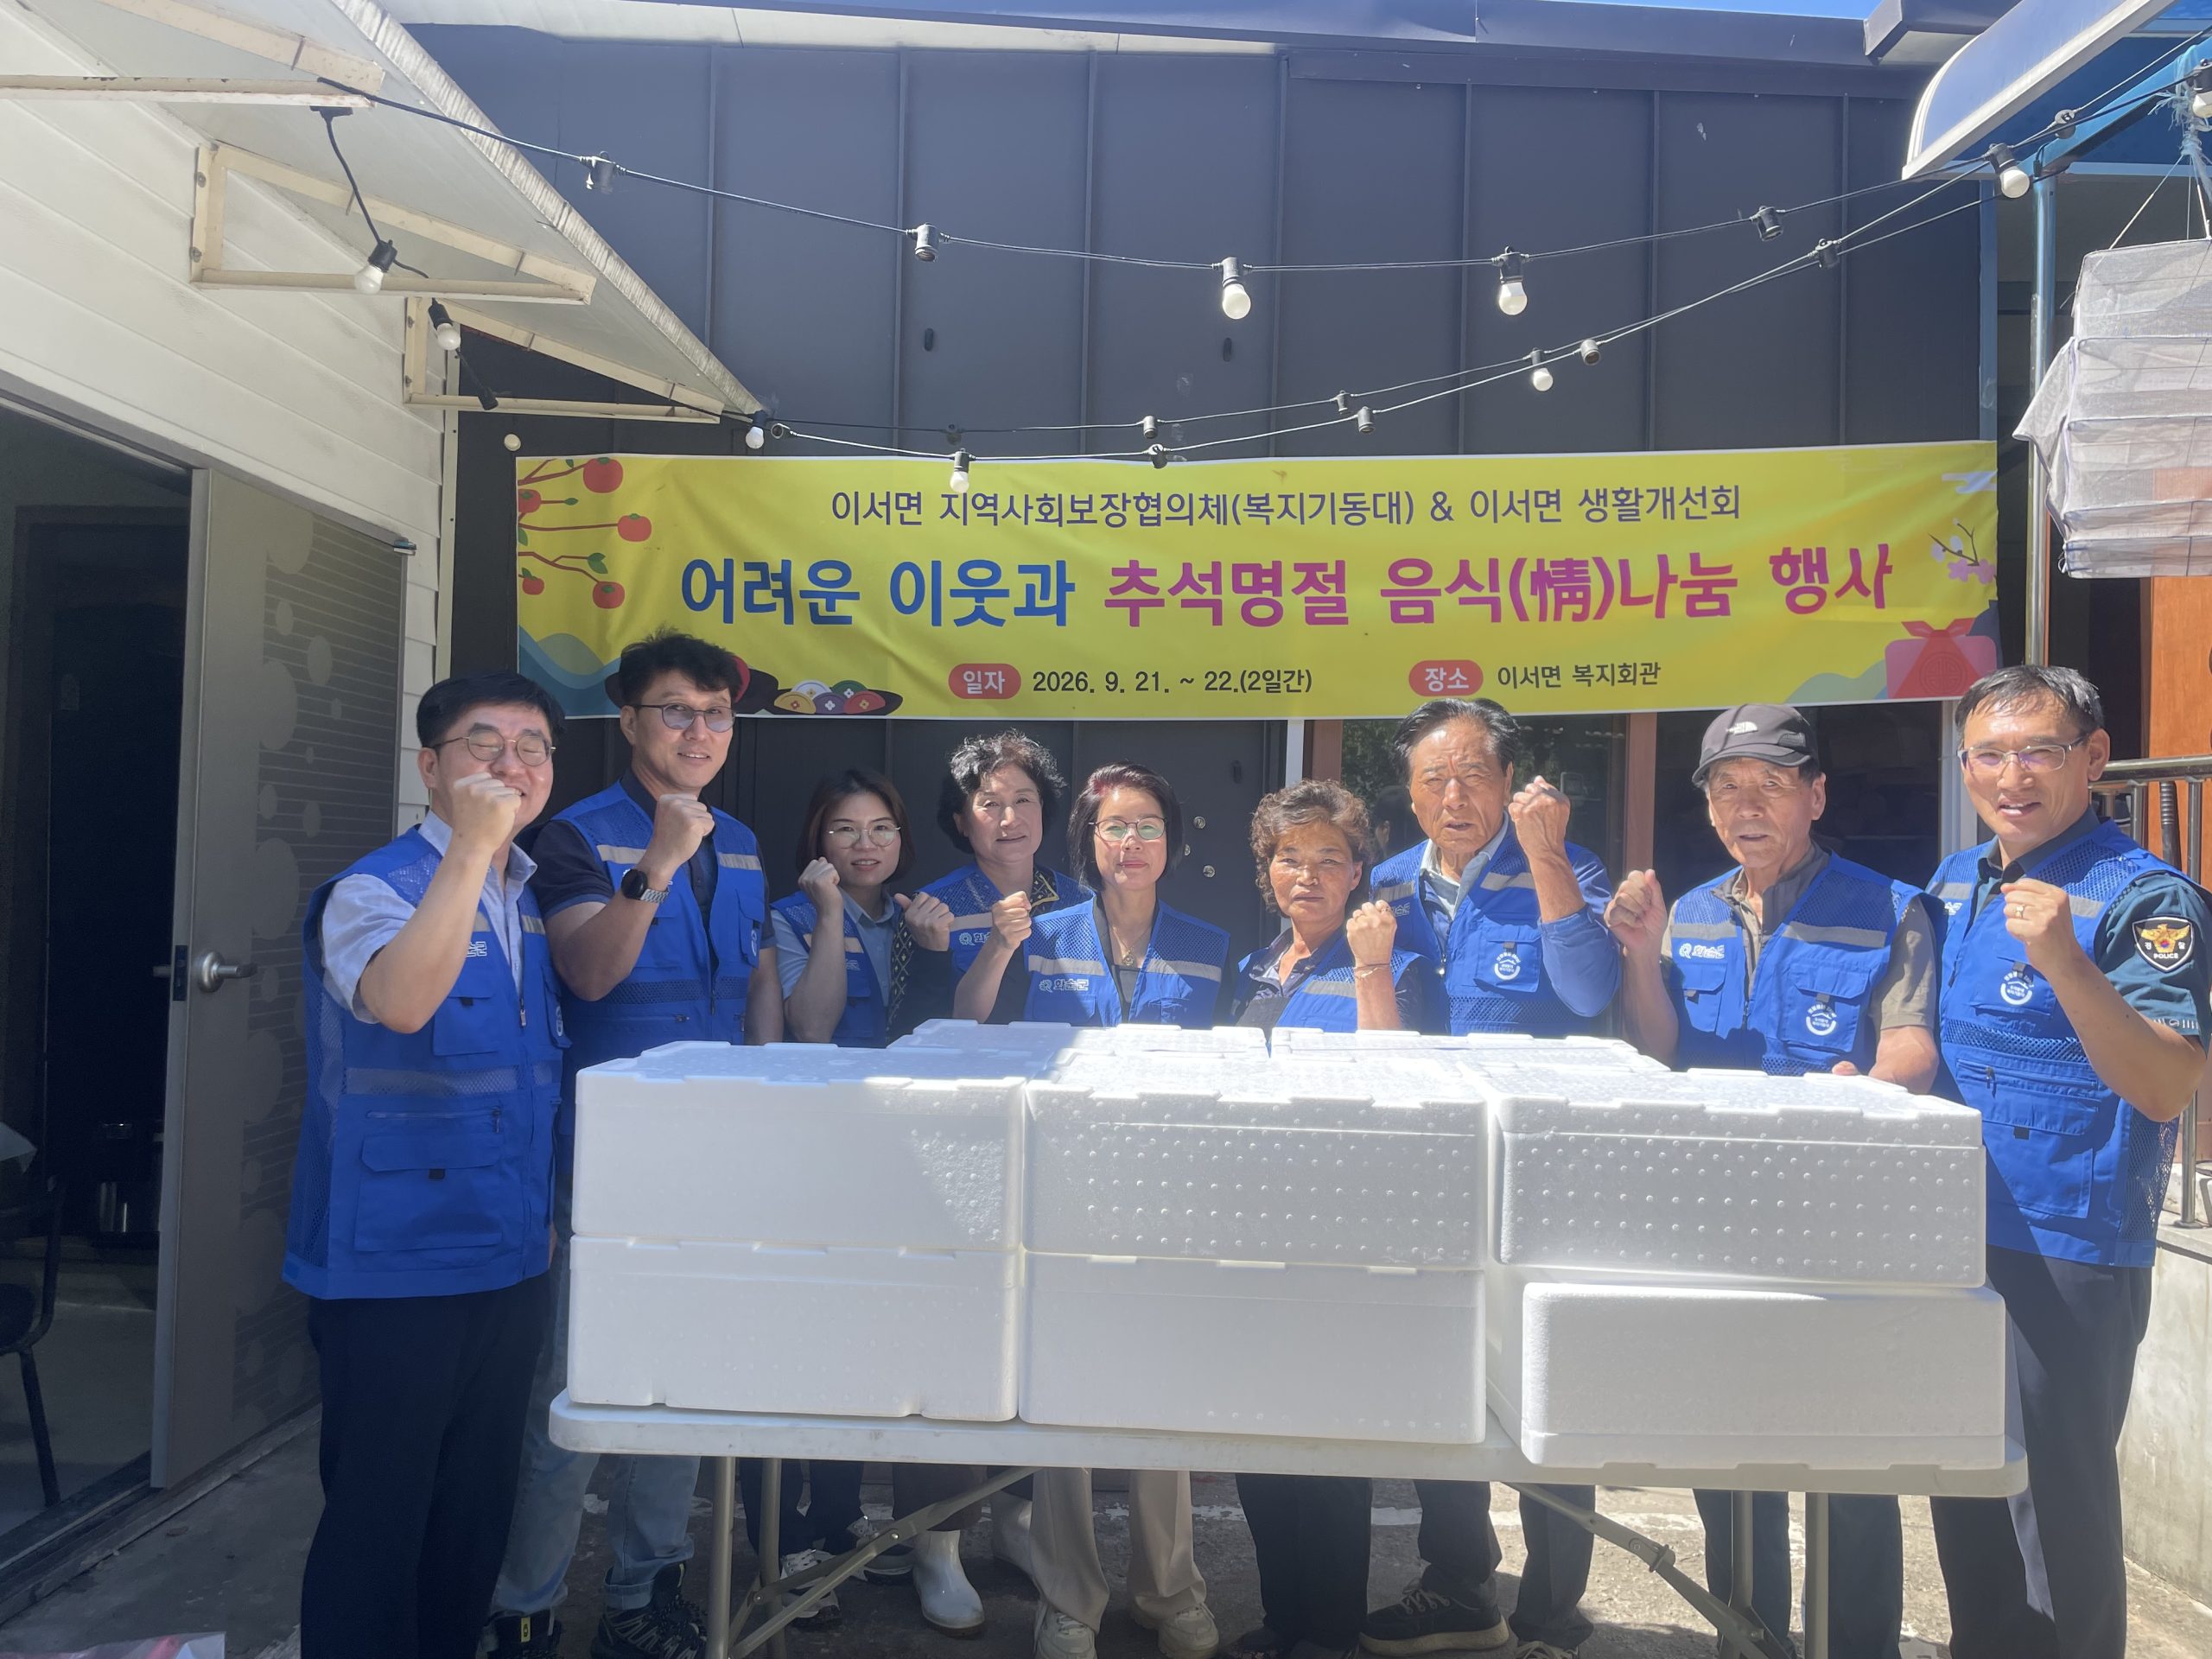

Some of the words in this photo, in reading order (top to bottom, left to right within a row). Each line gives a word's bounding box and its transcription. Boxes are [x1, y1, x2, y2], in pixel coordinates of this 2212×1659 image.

[831, 490, 923, 526] 이서면
[939, 486, 1414, 529] 지역사회보장협의체(복지기동대)
[1429, 491, 1453, 523] &
[1470, 488, 1562, 524] 이서면
[1579, 484, 1741, 523] 생활개선회
[681, 557, 862, 626] 어려운
[888, 558, 1077, 629] 이웃과
[1103, 558, 1350, 629] 추석명절
[1379, 551, 1738, 625] 음식(情)나눔
[1769, 542, 1893, 614] 행사
[963, 671, 1006, 695] 일자
[1033, 671, 1095, 694] 2026.
[1105, 671, 1125, 694] 9.
[1135, 671, 1169, 694] 21.
[1205, 669, 1313, 694] 22.(2일간)
[1424, 667, 1470, 692] 장소
[1497, 664, 1561, 690] 이서면
[1572, 662, 1662, 688] 복지회관
[1053, 978, 1089, 991] 화순군
